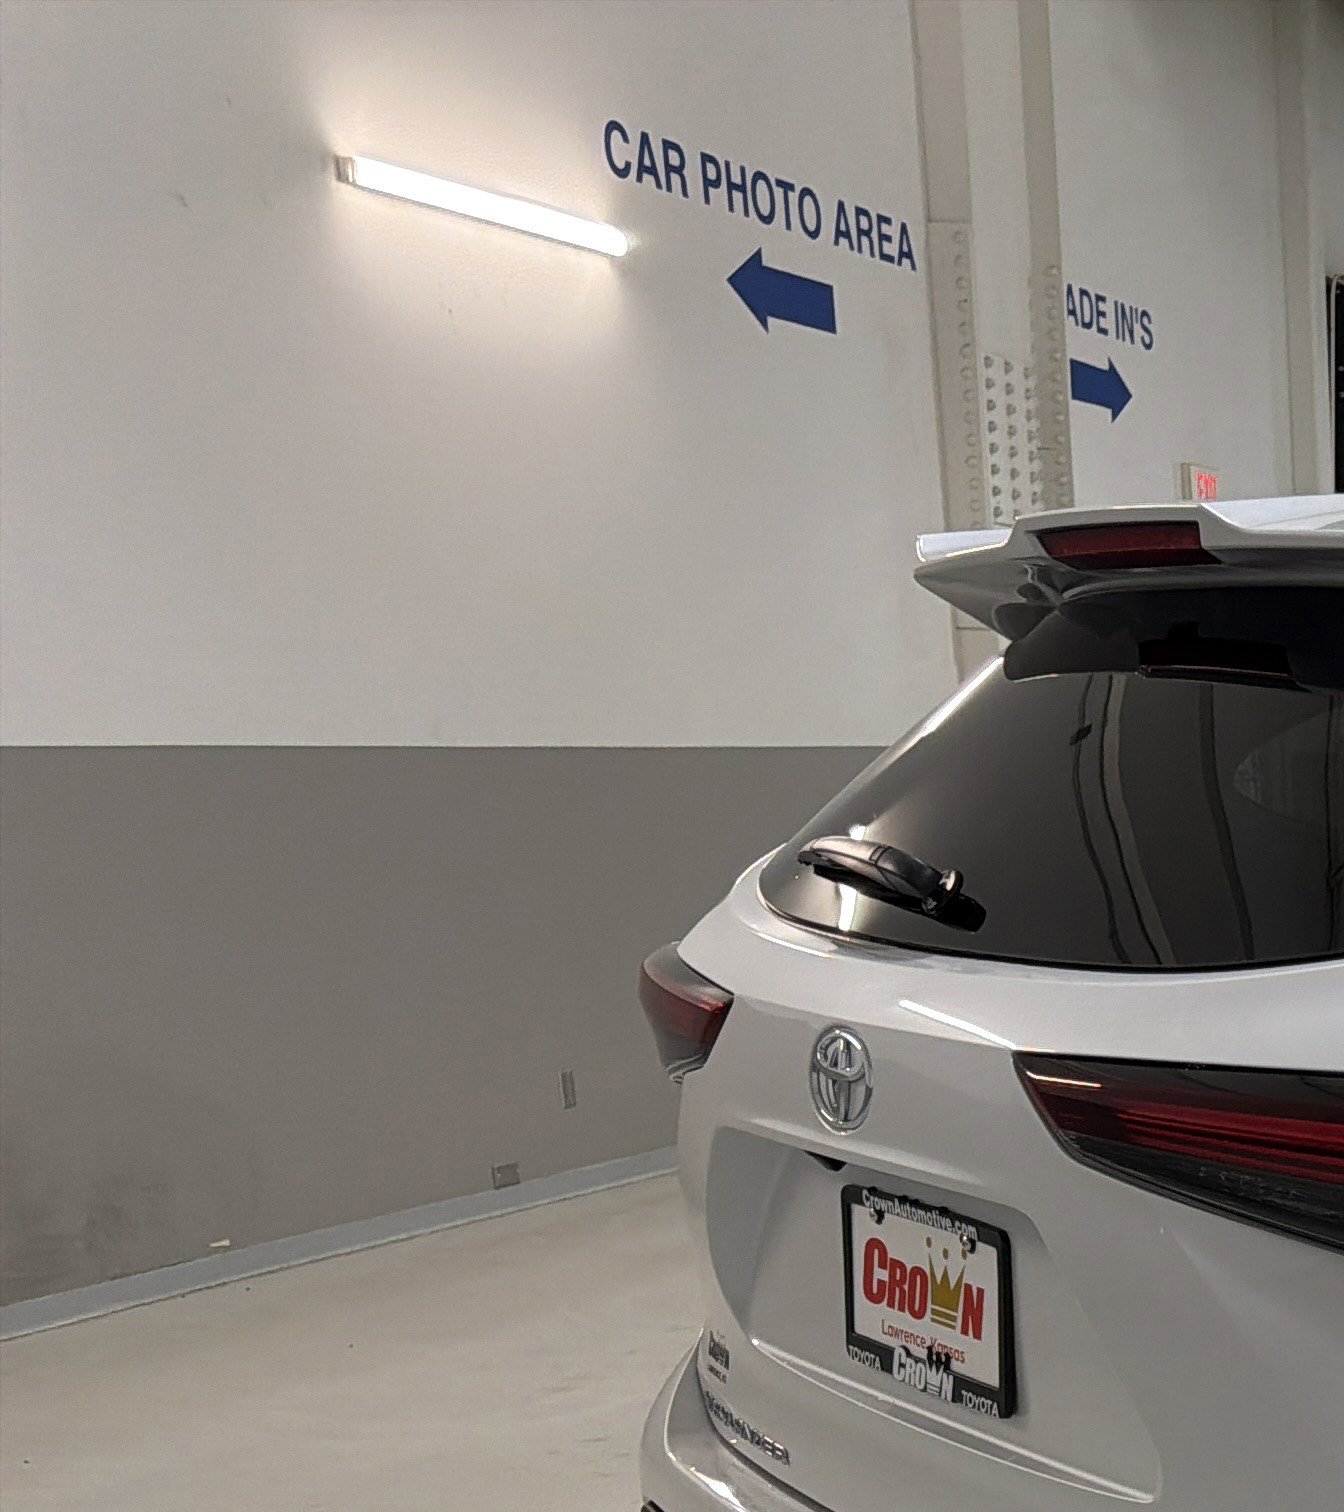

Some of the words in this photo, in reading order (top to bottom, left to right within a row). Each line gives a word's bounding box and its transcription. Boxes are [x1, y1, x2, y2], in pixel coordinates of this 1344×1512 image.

[603, 119, 689, 199] CAR
[699, 150, 822, 241] PHOTO
[833, 199, 917, 272] AREA
[1114, 301, 1154, 351] IN'S
[862, 1189, 977, 1240] CrownAutomotive.com
[863, 1236, 985, 1340] CROWN
[881, 1318, 926, 1349] Lawrence
[930, 1337, 966, 1364] Kansas
[848, 1345, 883, 1372] TOYOTA
[961, 1389, 999, 1418] TOYOTA
